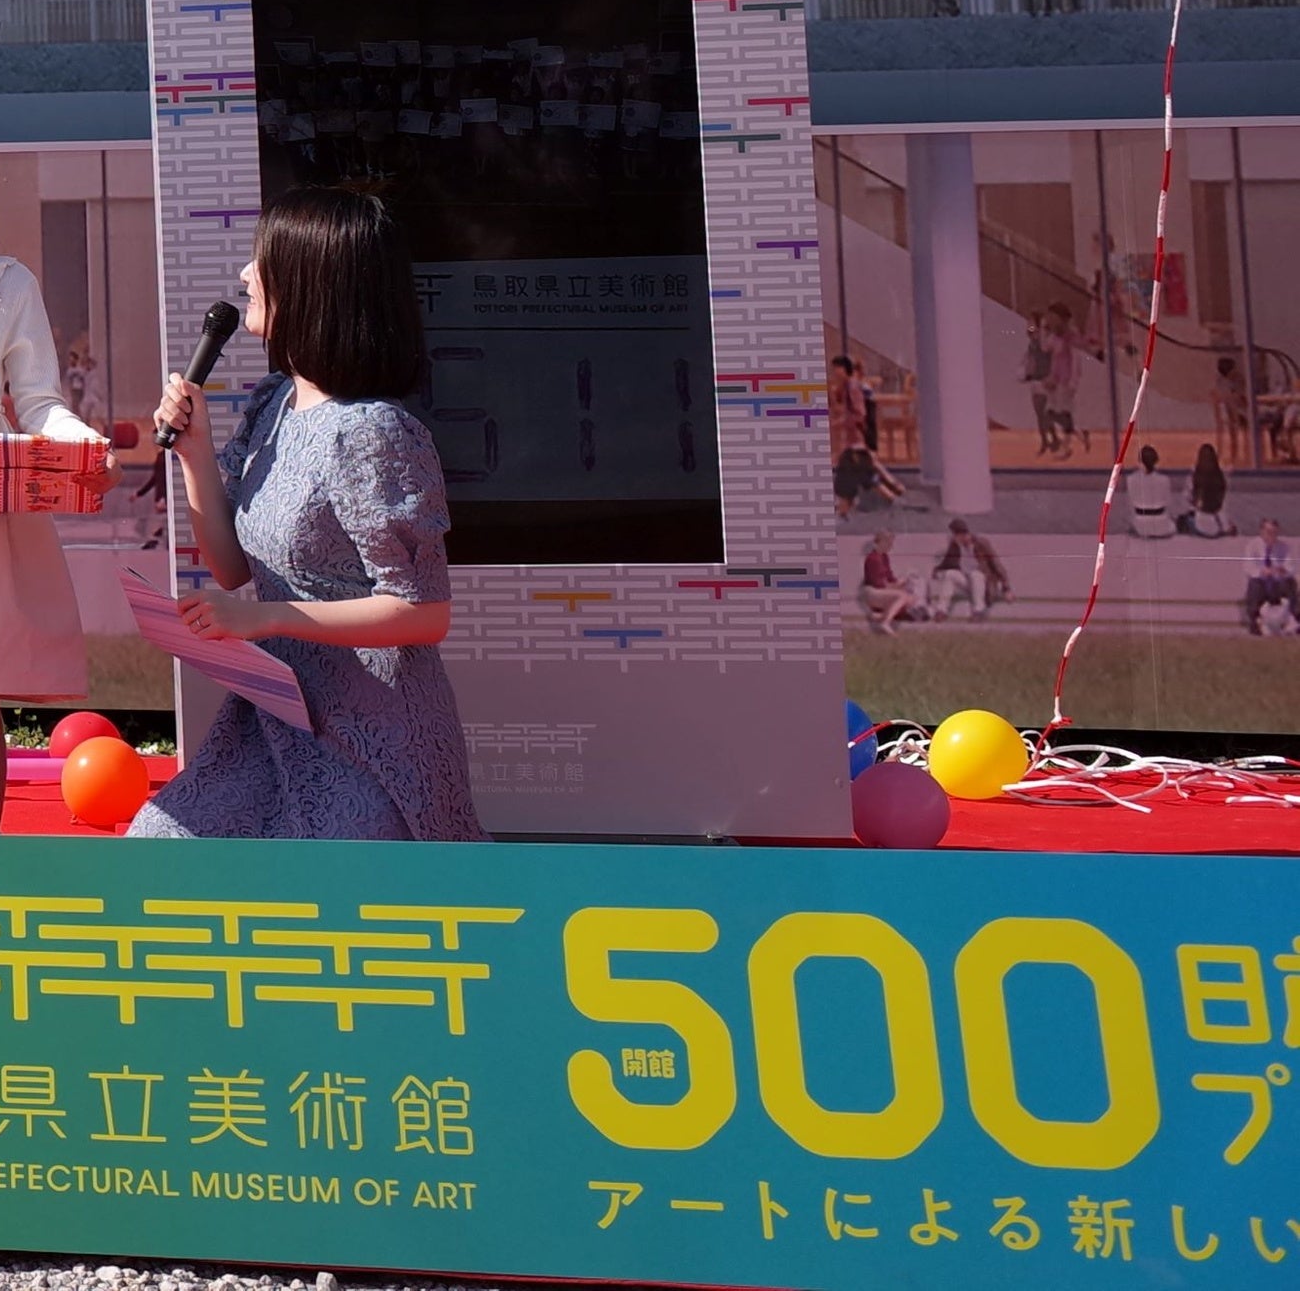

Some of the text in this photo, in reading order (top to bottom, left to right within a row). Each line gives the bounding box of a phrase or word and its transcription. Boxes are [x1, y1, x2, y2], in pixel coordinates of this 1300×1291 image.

[473, 273, 689, 299] 鳥取県立美術館
[563, 906, 1162, 1171] 500
[621, 1048, 676, 1079] 開館
[1191, 1062, 1292, 1166] プ
[190, 1170, 341, 1205] MUSEUM
[353, 1178, 402, 1208] OF
[412, 1181, 478, 1210] ART
